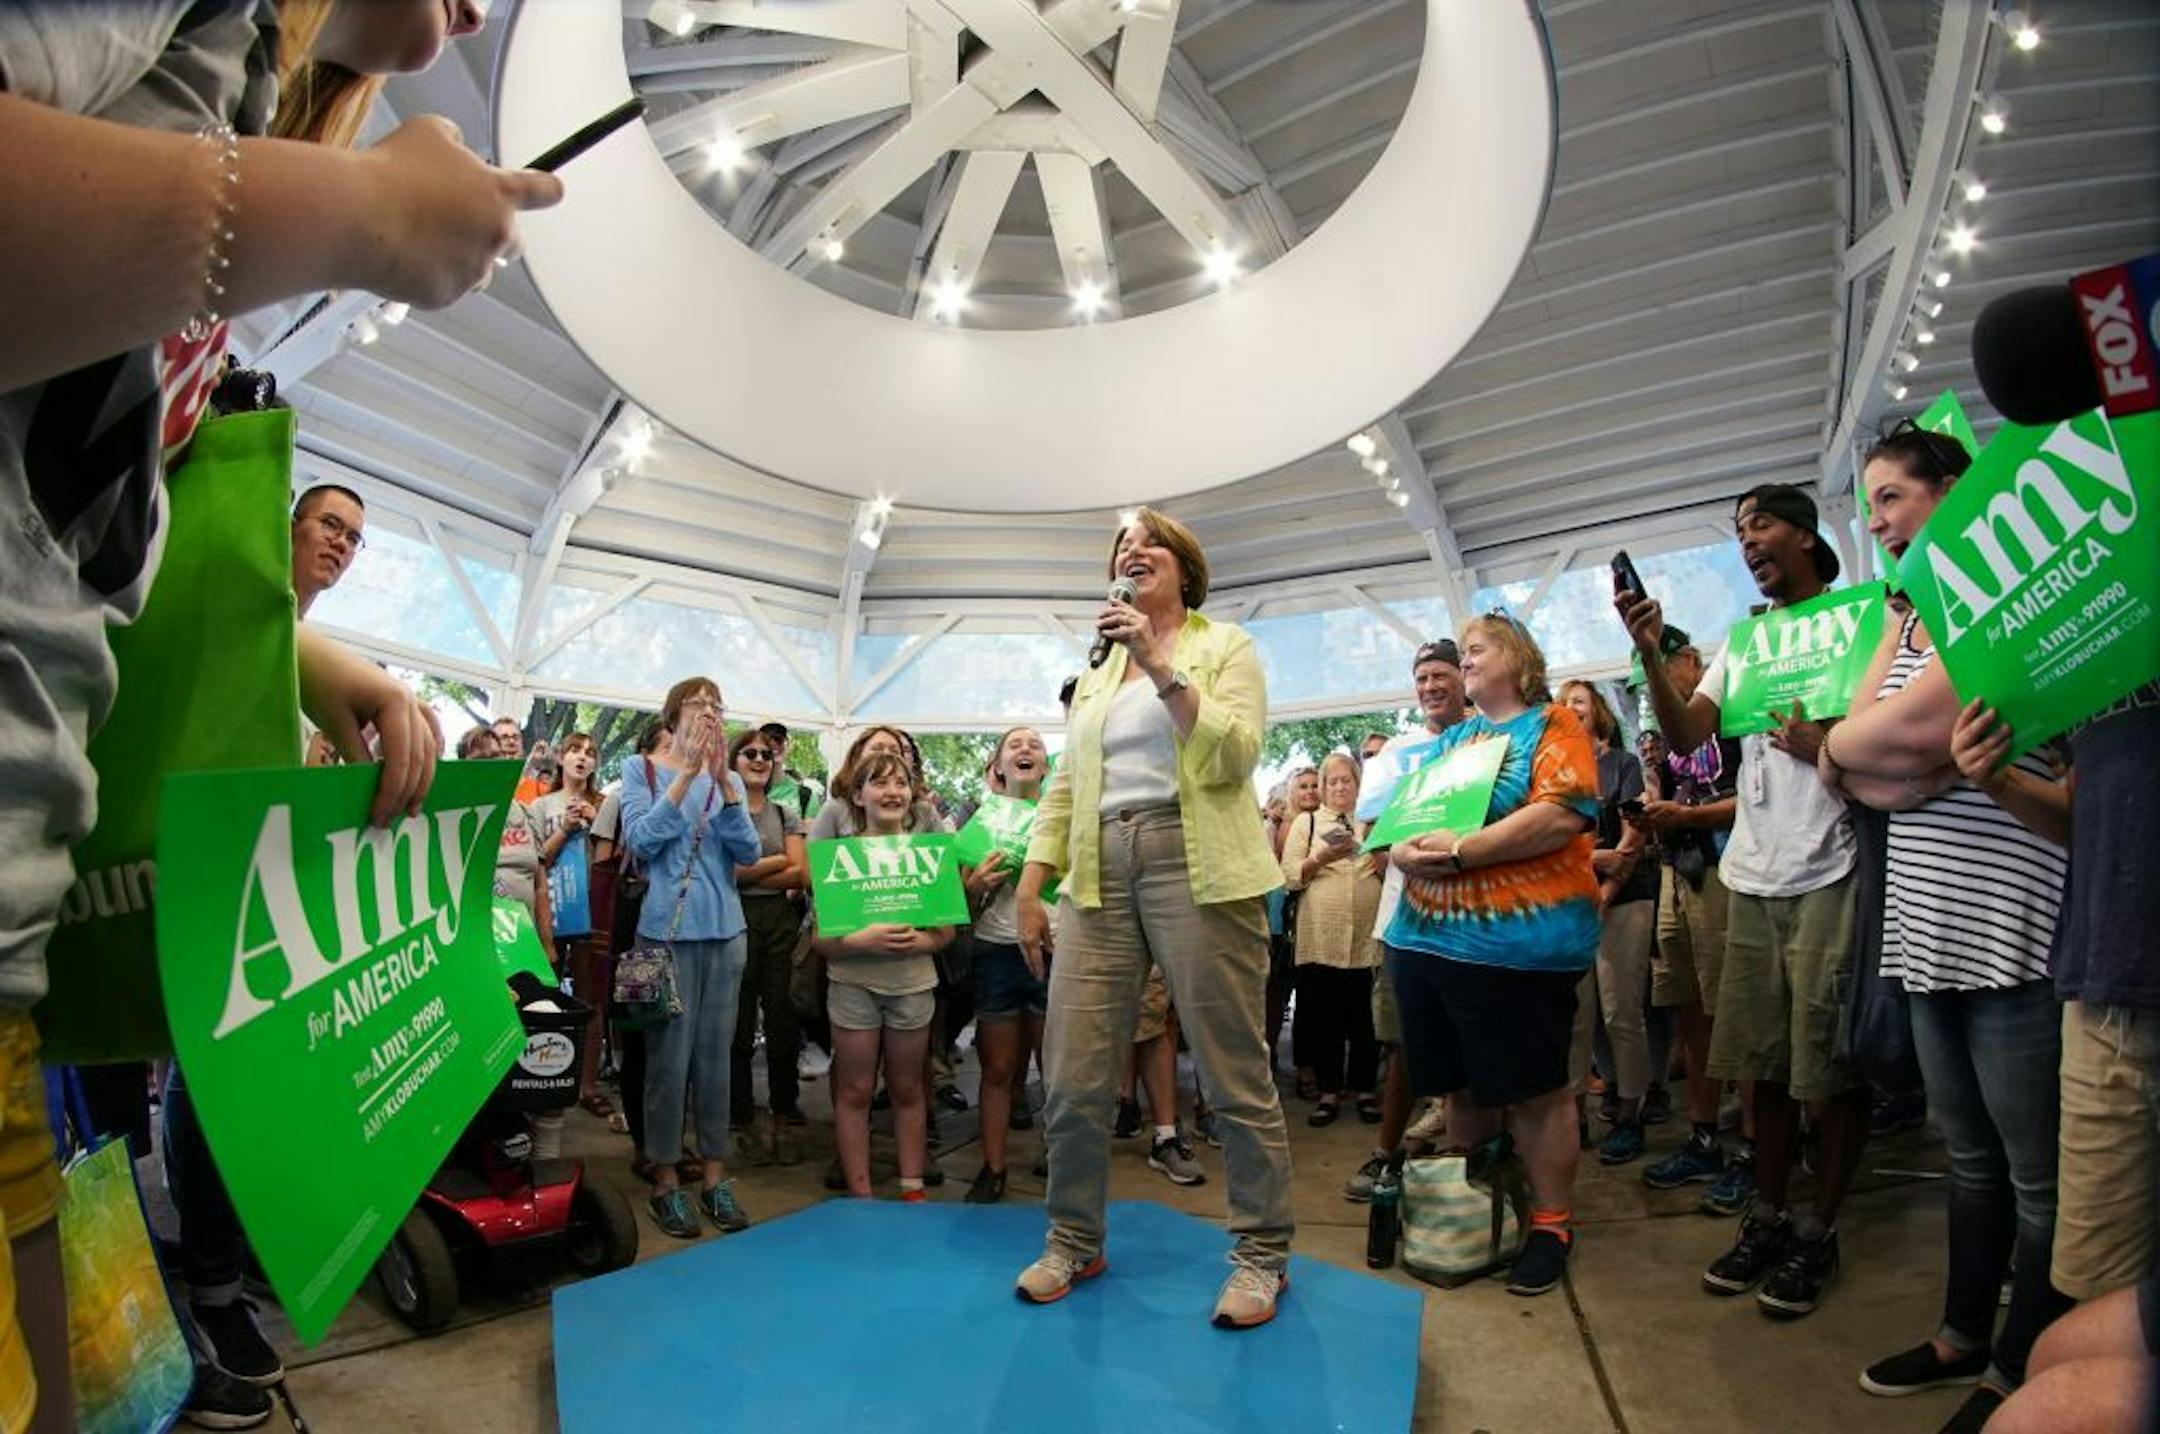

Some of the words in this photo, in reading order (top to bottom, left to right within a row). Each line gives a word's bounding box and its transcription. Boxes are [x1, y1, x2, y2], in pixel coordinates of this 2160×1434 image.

[2081, 284, 2149, 396] FOX
[1926, 406, 2137, 648] Amy
[1742, 599, 1873, 666] Amy
[2001, 537, 2113, 638] AMERICA
[2037, 617, 2079, 656] Amy
[2081, 581, 2127, 621] 91990
[1767, 653, 1830, 677] AMERICA
[824, 844, 945, 884] Amy
[861, 877, 920, 891] AMERICA
[213, 804, 497, 1040] Amy
[306, 1009, 332, 1051] for
[332, 934, 439, 1039] AMERICA
[370, 1026, 410, 1079] Amy
[412, 995, 445, 1038] 91990
[363, 1031, 461, 1143] AMYKLOBUCHAR.COM
